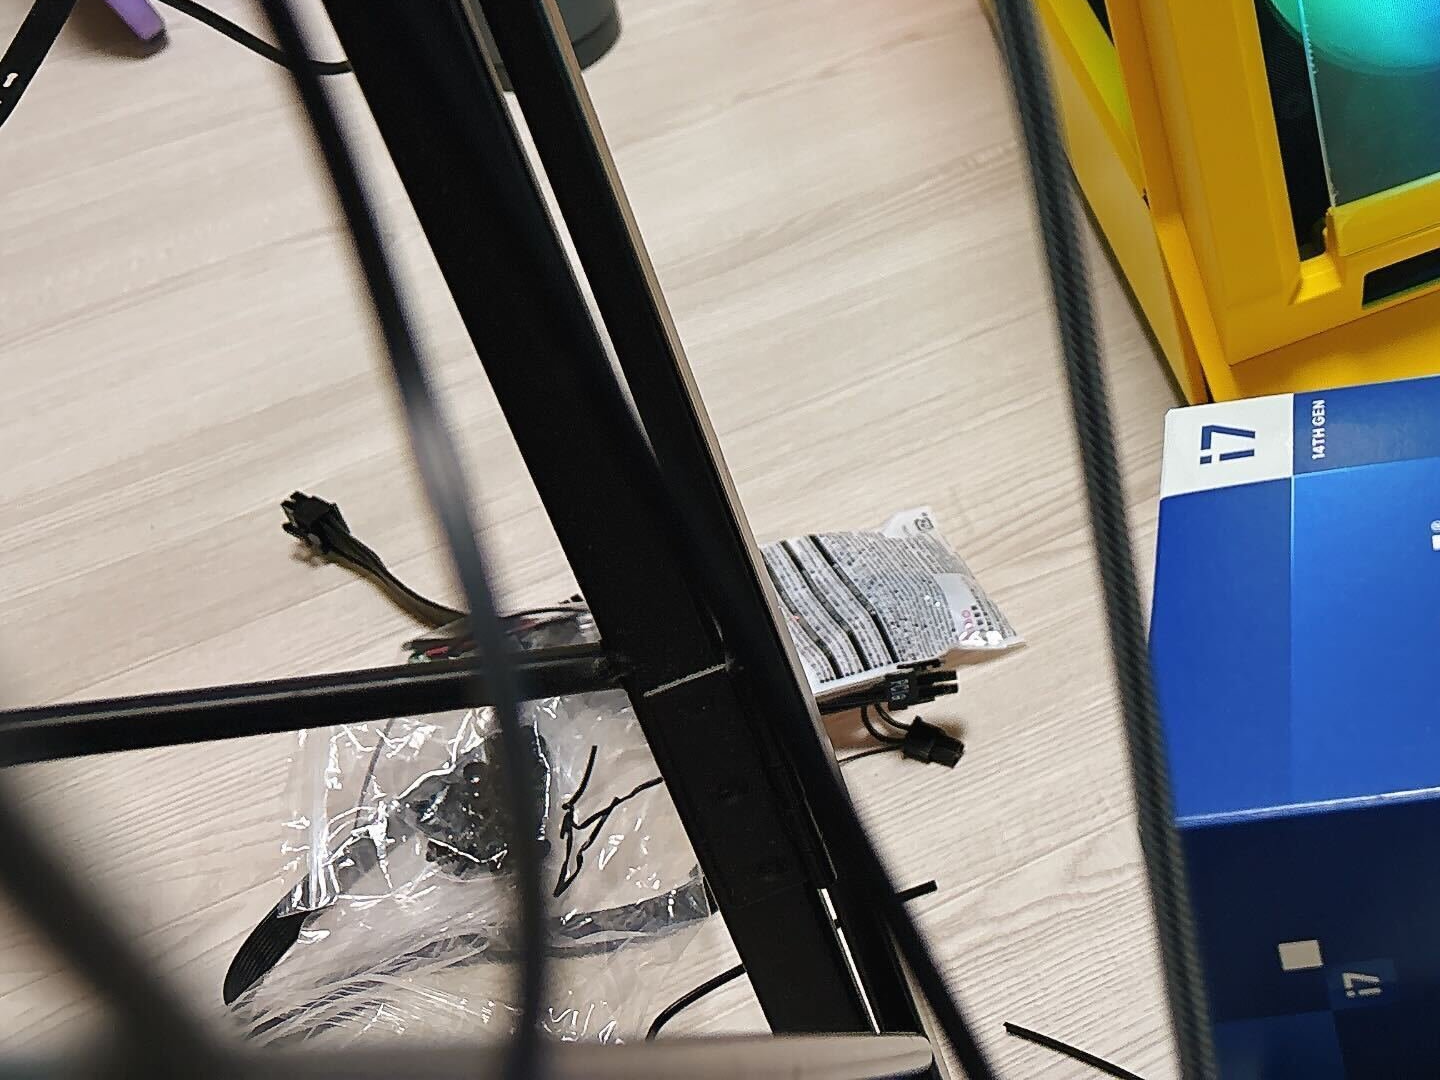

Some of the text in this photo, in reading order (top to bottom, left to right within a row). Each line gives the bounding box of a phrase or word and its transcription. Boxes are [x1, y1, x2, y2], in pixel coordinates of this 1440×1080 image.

[1200, 425, 1256, 465] i7
[1311, 399, 1326, 460] 14TH GEN
[1342, 972, 1383, 998] i7
